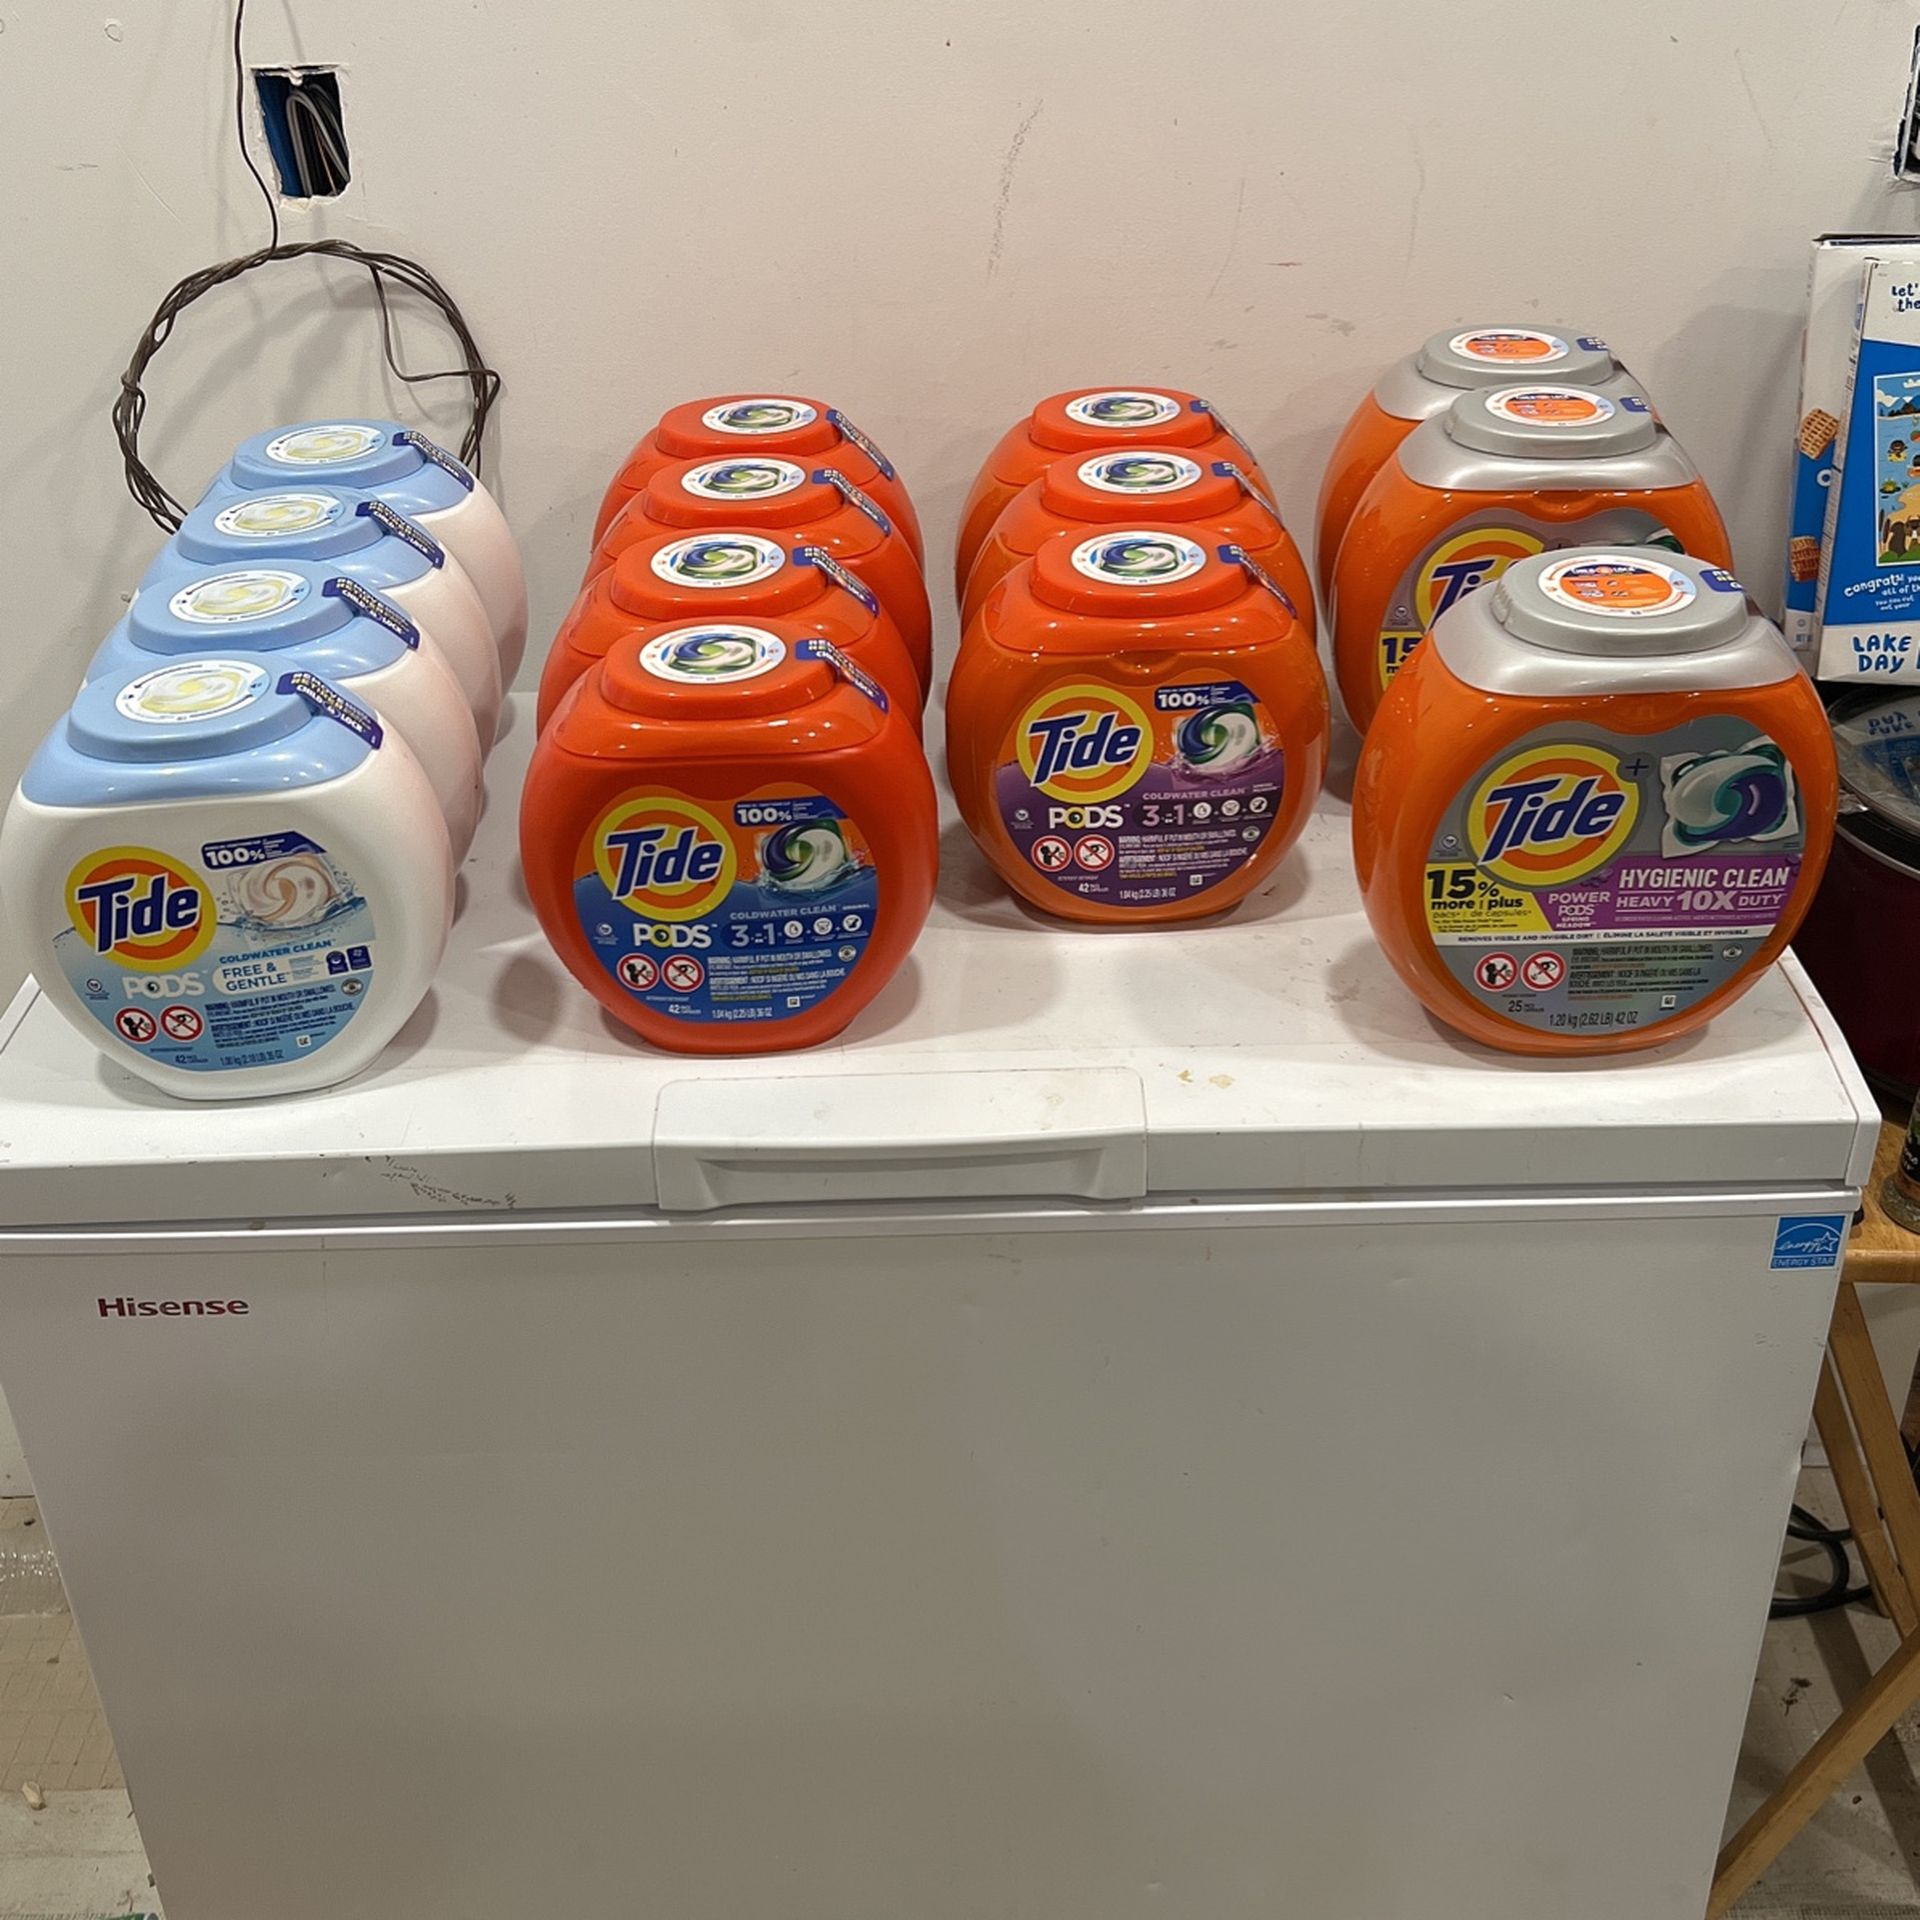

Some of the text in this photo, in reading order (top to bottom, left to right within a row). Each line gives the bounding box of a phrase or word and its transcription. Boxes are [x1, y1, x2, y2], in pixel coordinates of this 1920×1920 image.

[1852, 633, 1912, 653] LAKE
[1858, 654, 1905, 674] DAY
[1158, 692, 1210, 708] 100%
[1027, 711, 1142, 787] Tide
[1142, 790, 1208, 801] COLDWATER
[1210, 788, 1245, 797] CLEAN
[737, 807, 792, 823] 100%
[1048, 805, 1124, 829] PODS
[1476, 775, 1624, 865] Tide
[206, 846, 267, 867] 100%
[605, 826, 723, 900] Tide
[1078, 882, 1089, 893] 42
[1427, 869, 1500, 899] 15%
[1618, 866, 1791, 889] HYGIENIC CLEAN
[1431, 896, 1524, 911] more plus
[1548, 891, 1611, 905] POWER
[1615, 890, 1783, 911] HEAVY 10X DUTY
[78, 875, 200, 954] Tide
[730, 908, 799, 920] COLDWATER
[799, 904, 836, 916] CLEAN
[1558, 903, 1596, 917] PODS
[633, 923, 712, 948] PODS
[219, 939, 332, 964] COLDWATER CLEAN
[222, 962, 277, 979] FREE &
[122, 972, 206, 999] PODS
[225, 974, 288, 992] GENTLE
[668, 1004, 681, 1014] 42
[1508, 1000, 1523, 1013] 25
[175, 1055, 186, 1064] 42
[1809, 1256, 1835, 1266] STAR
[97, 1297, 250, 1318] Hisense
